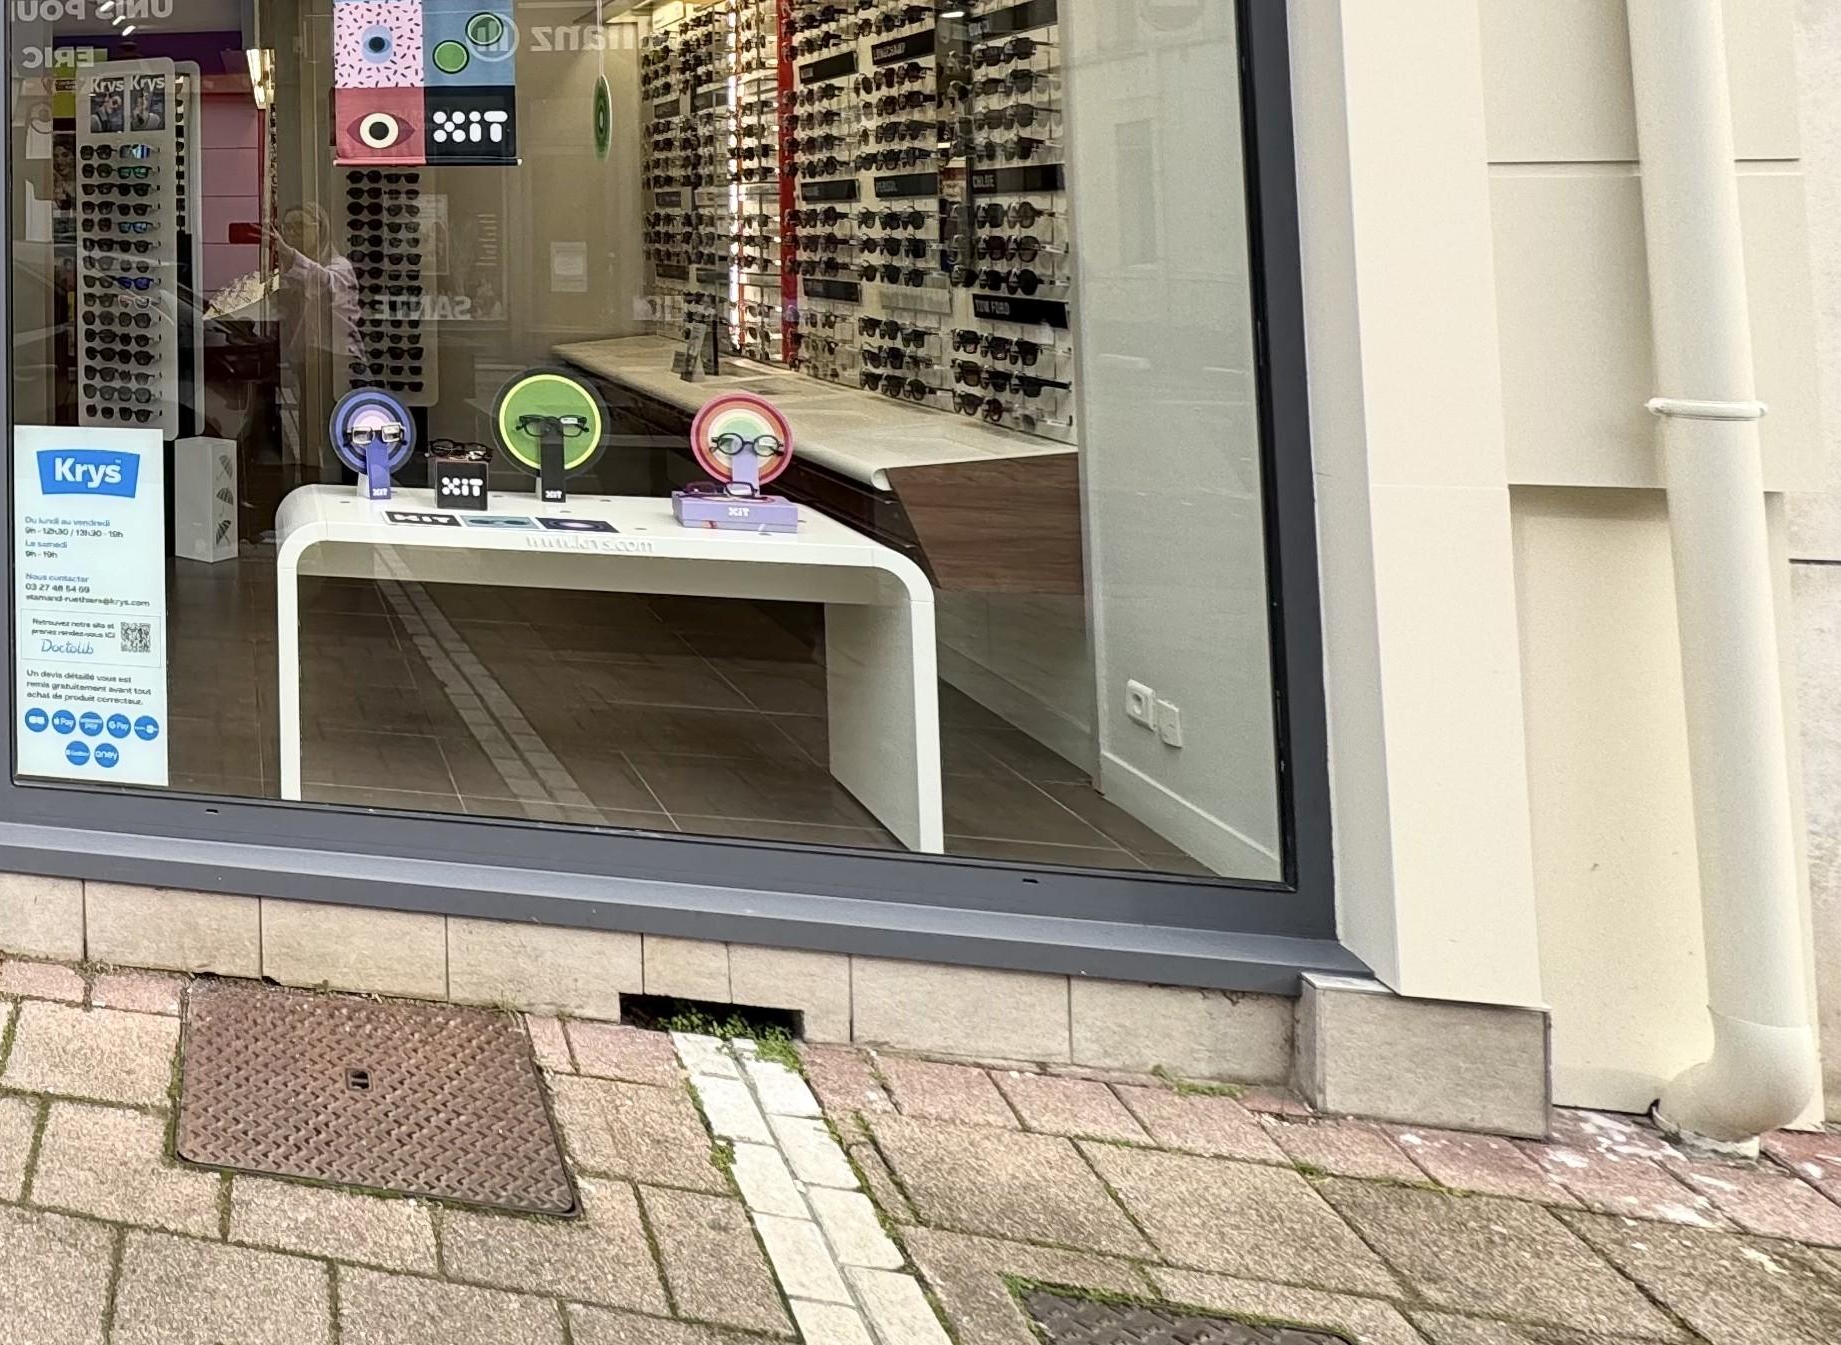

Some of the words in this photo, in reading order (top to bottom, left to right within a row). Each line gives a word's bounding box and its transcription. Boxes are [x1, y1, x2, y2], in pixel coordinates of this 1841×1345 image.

[55, 458, 121, 488] Krys
[39, 517, 58, 525] lundi
[39, 583, 49, 591] 27
[27, 669, 38, 677] Un
[41, 670, 62, 678] devis
[27, 691, 50, 699] achat
[65, 694, 94, 702] produit
